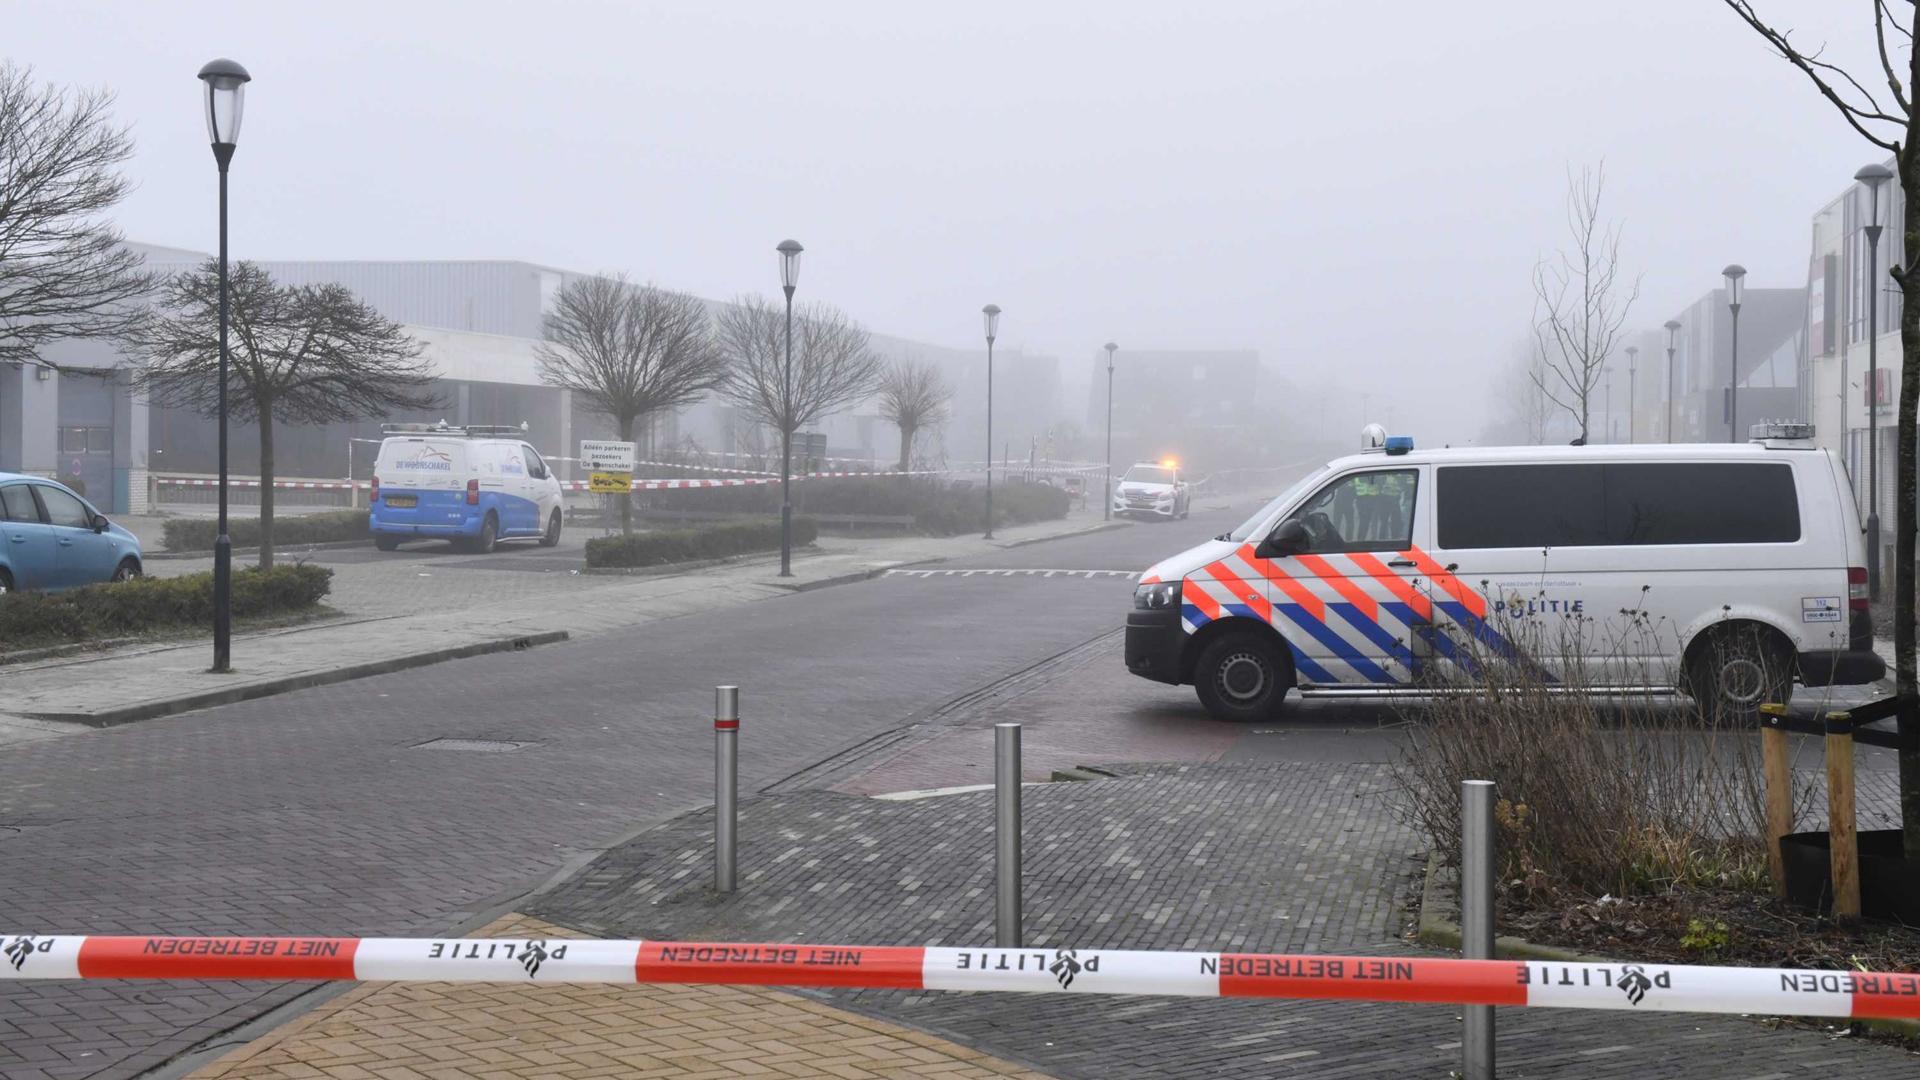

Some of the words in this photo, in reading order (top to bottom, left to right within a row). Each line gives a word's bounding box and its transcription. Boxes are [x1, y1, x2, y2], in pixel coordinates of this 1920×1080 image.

[395, 461, 404, 469] DE
[404, 461, 451, 471] WOONSCHAKEL
[144, 938, 278, 955] BETREDEN
[282, 941, 340, 957] NIET
[428, 940, 568, 961] POLITIE
[660, 946, 798, 964] BETREDEN
[803, 949, 862, 966] NIET
[956, 950, 1101, 973] POLITIE
[1200, 957, 1344, 978] BETREDEN
[1353, 961, 1413, 981] NIET
[1516, 964, 1672, 989] POLITIE
[1780, 973, 1920, 996] ETREDEN
